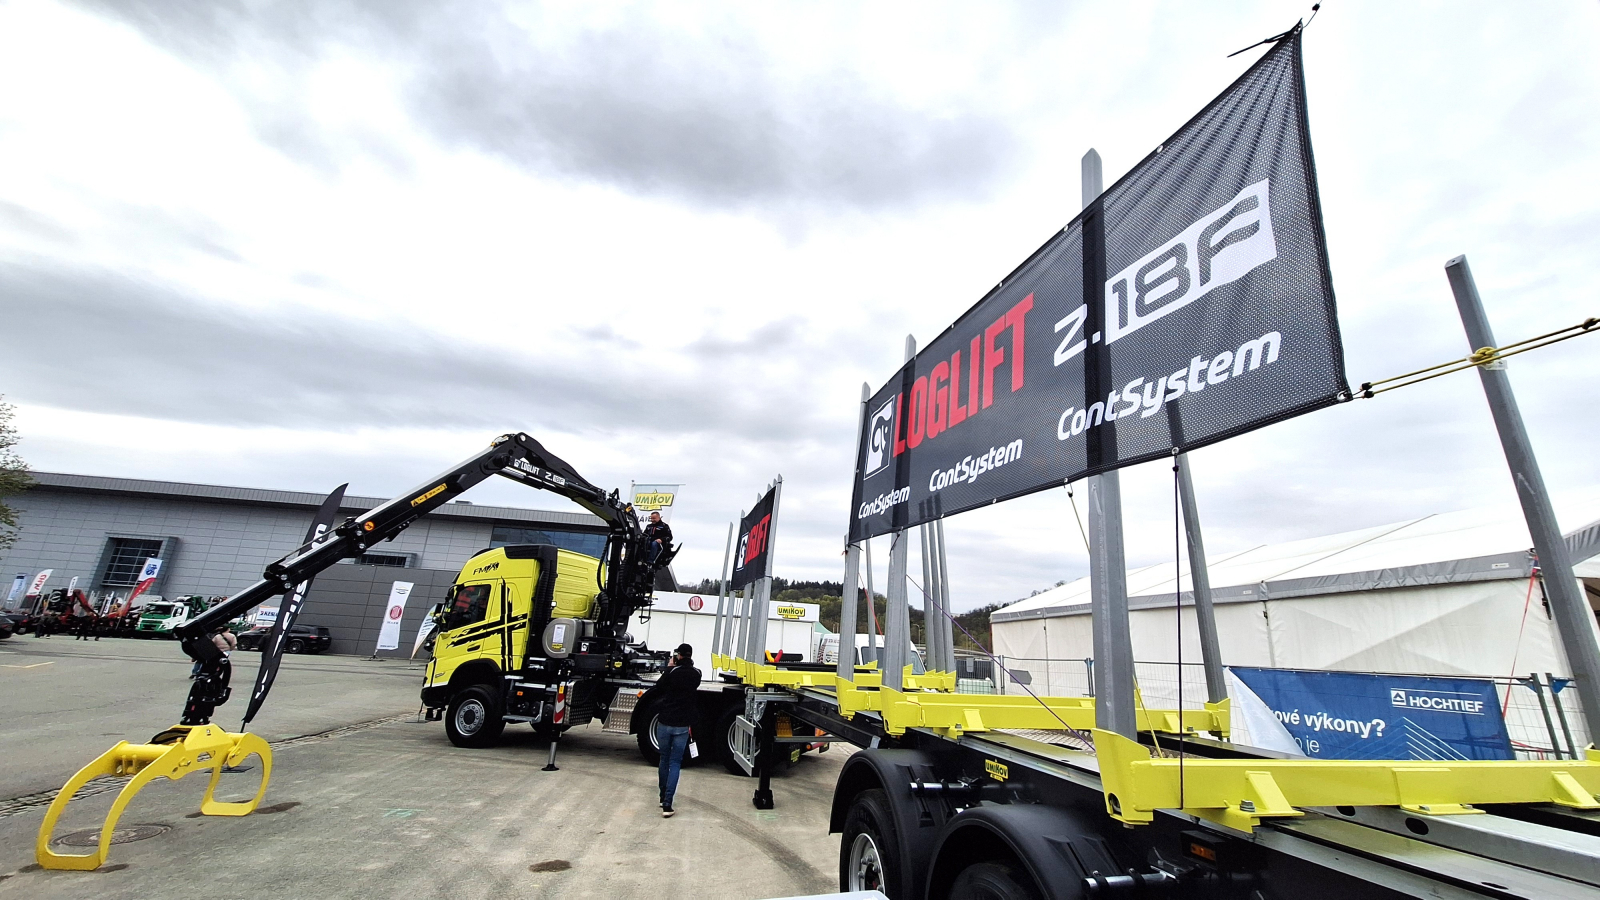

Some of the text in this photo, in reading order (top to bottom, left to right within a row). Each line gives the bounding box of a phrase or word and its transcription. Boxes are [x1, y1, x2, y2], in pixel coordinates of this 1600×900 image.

[892, 292, 1034, 458] LOGLIFT
[858, 330, 1282, 519] ContSystem ContSystem ContSystem
[635, 494, 671, 505] UMIKOV
[778, 607, 804, 616] UMIKOV
[1409, 696, 1484, 712] HOCHTIEF
[1270, 708, 1386, 739] ové výkony?
[1306, 735, 1320, 755] je
[985, 761, 1008, 777] UMIKOV
